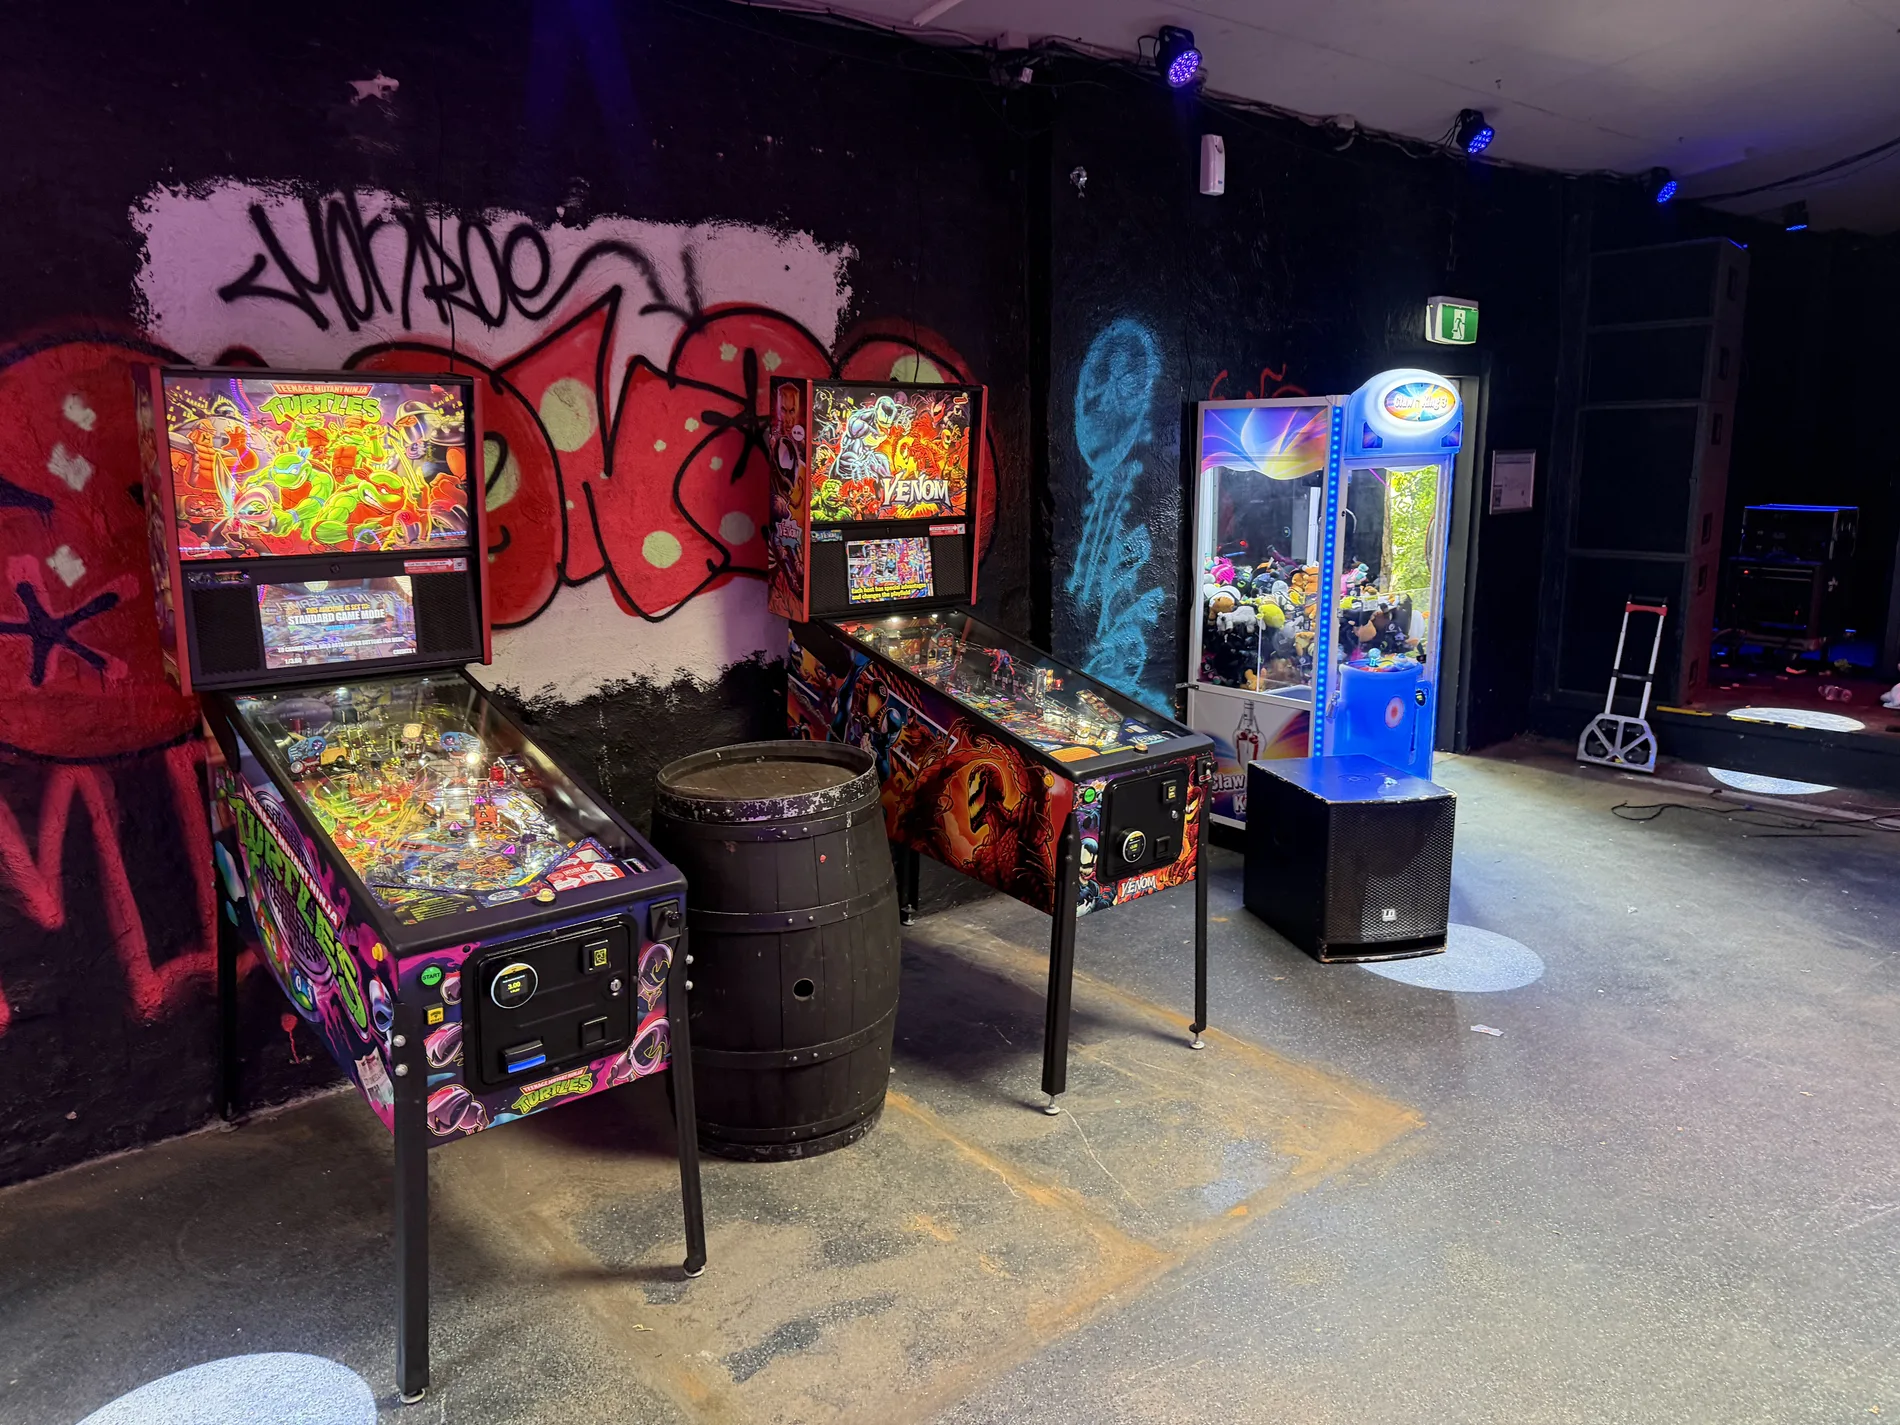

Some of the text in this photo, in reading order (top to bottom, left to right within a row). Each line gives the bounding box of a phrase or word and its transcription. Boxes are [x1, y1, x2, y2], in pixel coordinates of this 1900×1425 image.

[277, 384, 368, 393] TEENAGE MUTANT NINJA
[259, 392, 382, 425] TURTLES
[881, 471, 952, 507] VENOM
[287, 608, 386, 626] STANDARD GAME MODE
[242, 787, 340, 926] TEENAGE MUTANT NINJA
[1121, 876, 1157, 898] VENOM
[227, 794, 369, 1030] TURTLES
[422, 972, 441, 980] START
[507, 981, 522, 990] 3.00
[512, 1073, 593, 1115] TURTLES
